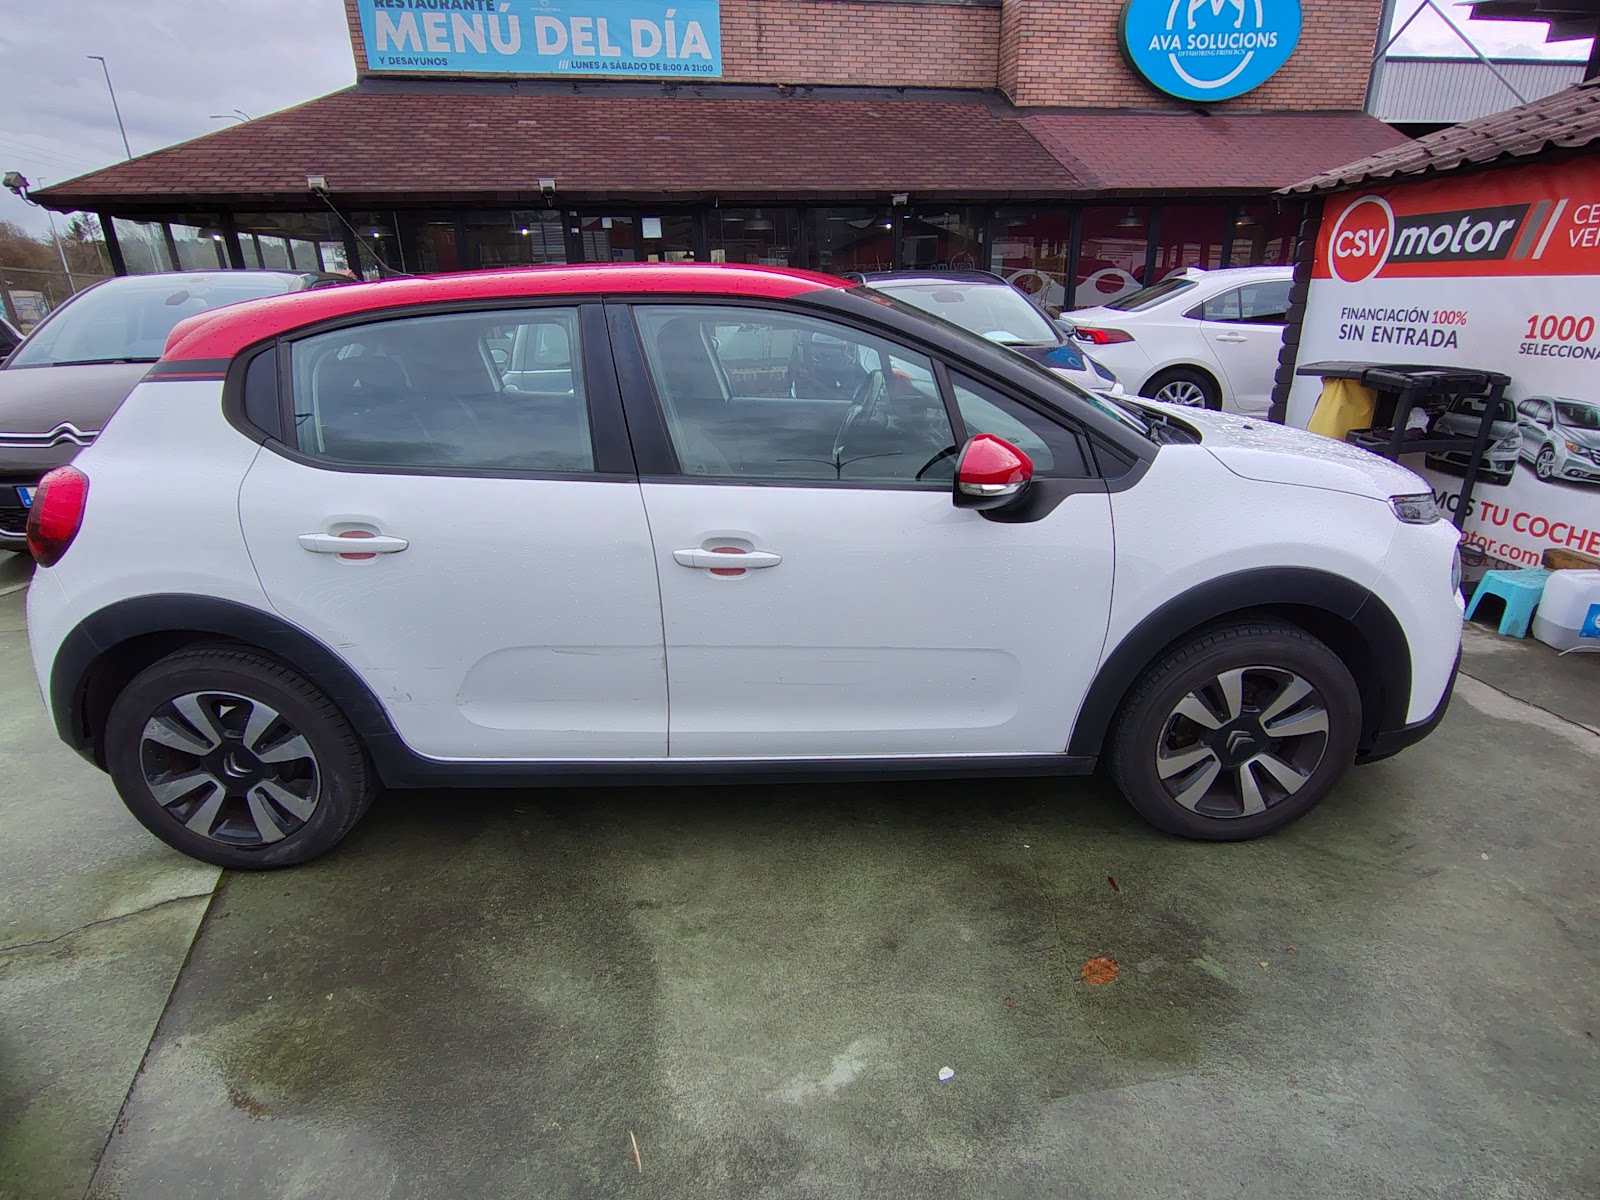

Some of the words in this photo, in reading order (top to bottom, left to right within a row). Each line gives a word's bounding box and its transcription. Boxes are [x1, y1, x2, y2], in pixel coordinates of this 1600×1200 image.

[375, 2, 521, 55] MENÚ
[534, 15, 621, 57] DEL
[630, 8, 712, 59] DÍA
[1149, 34, 1182, 50] AVA
[1187, 32, 1278, 50] SOLUCIONS
[378, 56, 386, 65] Y
[388, 57, 448, 66] DESAYUNOS
[571, 60, 600, 70] LUNES
[602, 61, 609, 70] A
[610, 59, 648, 71] SÁBADO
[650, 63, 661, 71] DE
[663, 63, 682, 72] 8:00
[691, 64, 713, 72] 21:00
[1335, 227, 1387, 258] CSV
[1393, 215, 1517, 256] motor
[1569, 227, 1600, 248] VE
[1340, 306, 1430, 324] FINANCIACIÓN
[1432, 310, 1468, 326] 100%
[1339, 324, 1365, 342] SIN
[1371, 326, 1458, 349] ENTRADA
[1524, 315, 1595, 343] 1000
[1481, 501, 1509, 526] TU
[1513, 512, 1600, 555] COCHE
